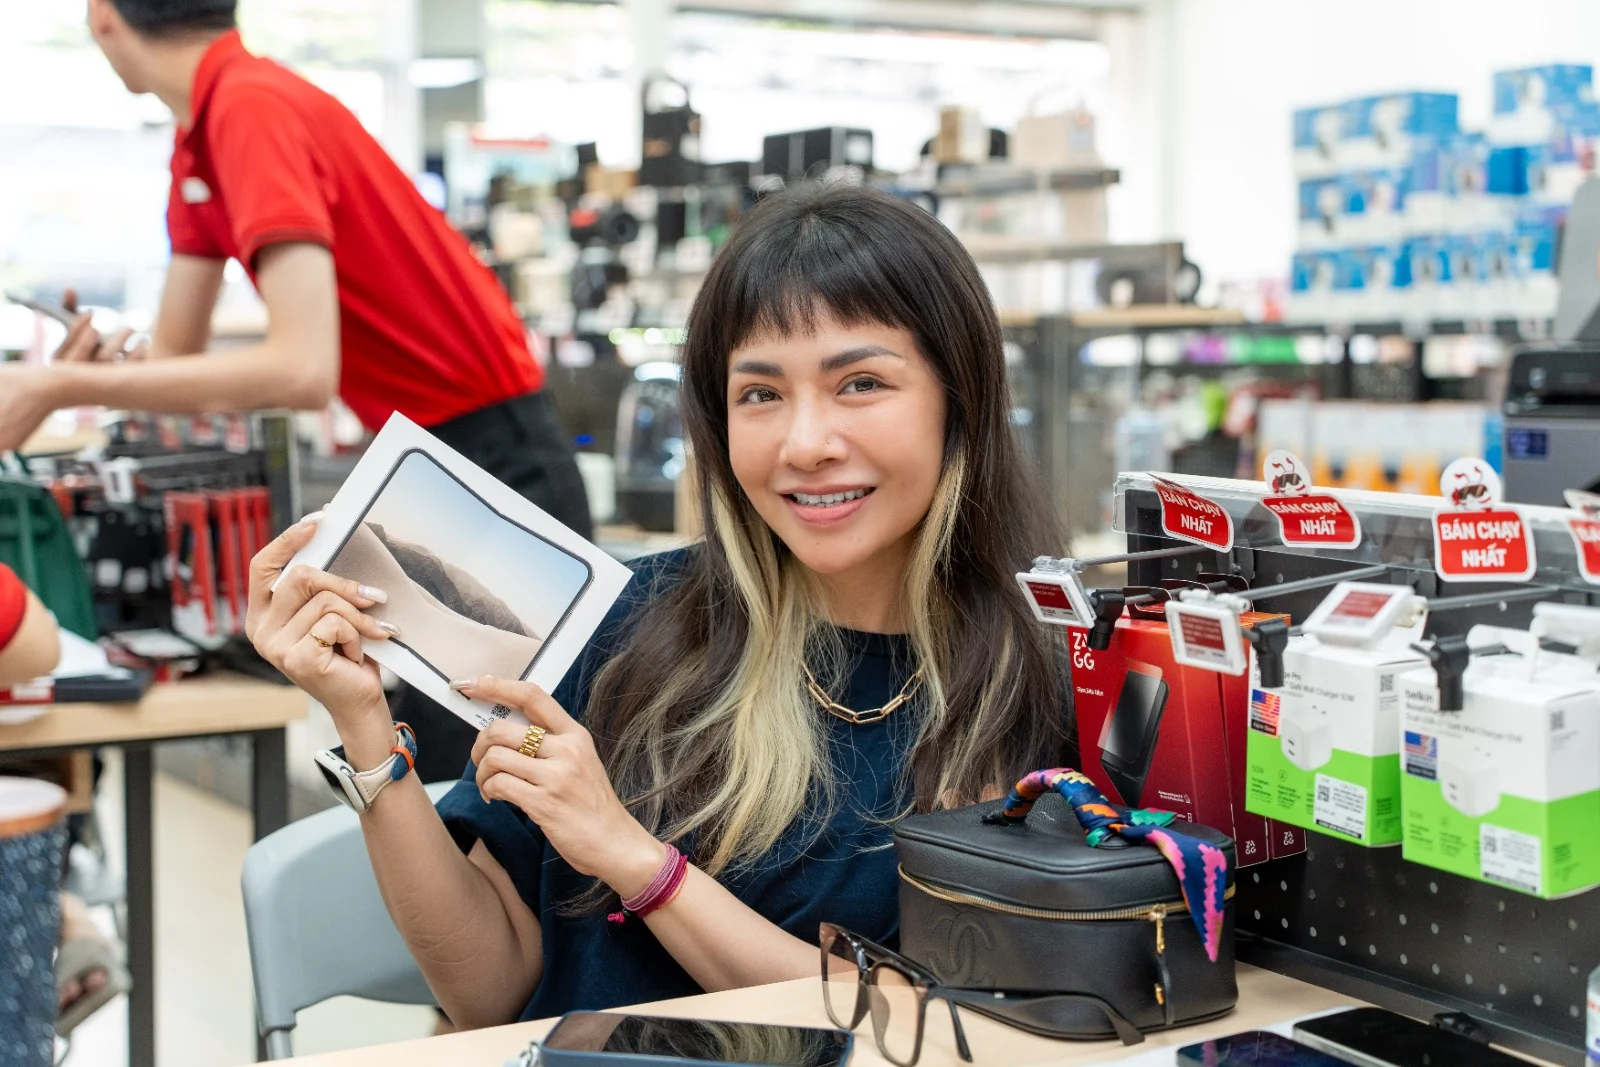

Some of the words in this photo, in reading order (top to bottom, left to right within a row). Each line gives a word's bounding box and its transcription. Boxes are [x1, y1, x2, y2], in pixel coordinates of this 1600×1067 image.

[1187, 498, 1222, 518] CHẠY
[1270, 500, 1301, 514] BÁN
[1301, 502, 1342, 516] CHẠY
[1181, 513, 1213, 535] NHẤT
[1300, 515, 1336, 536] NHẤT
[1440, 518, 1475, 541] BÁN
[1476, 520, 1521, 543] CHẠY
[1462, 543, 1507, 568] NHẤT
[1074, 651, 1095, 671] GG
